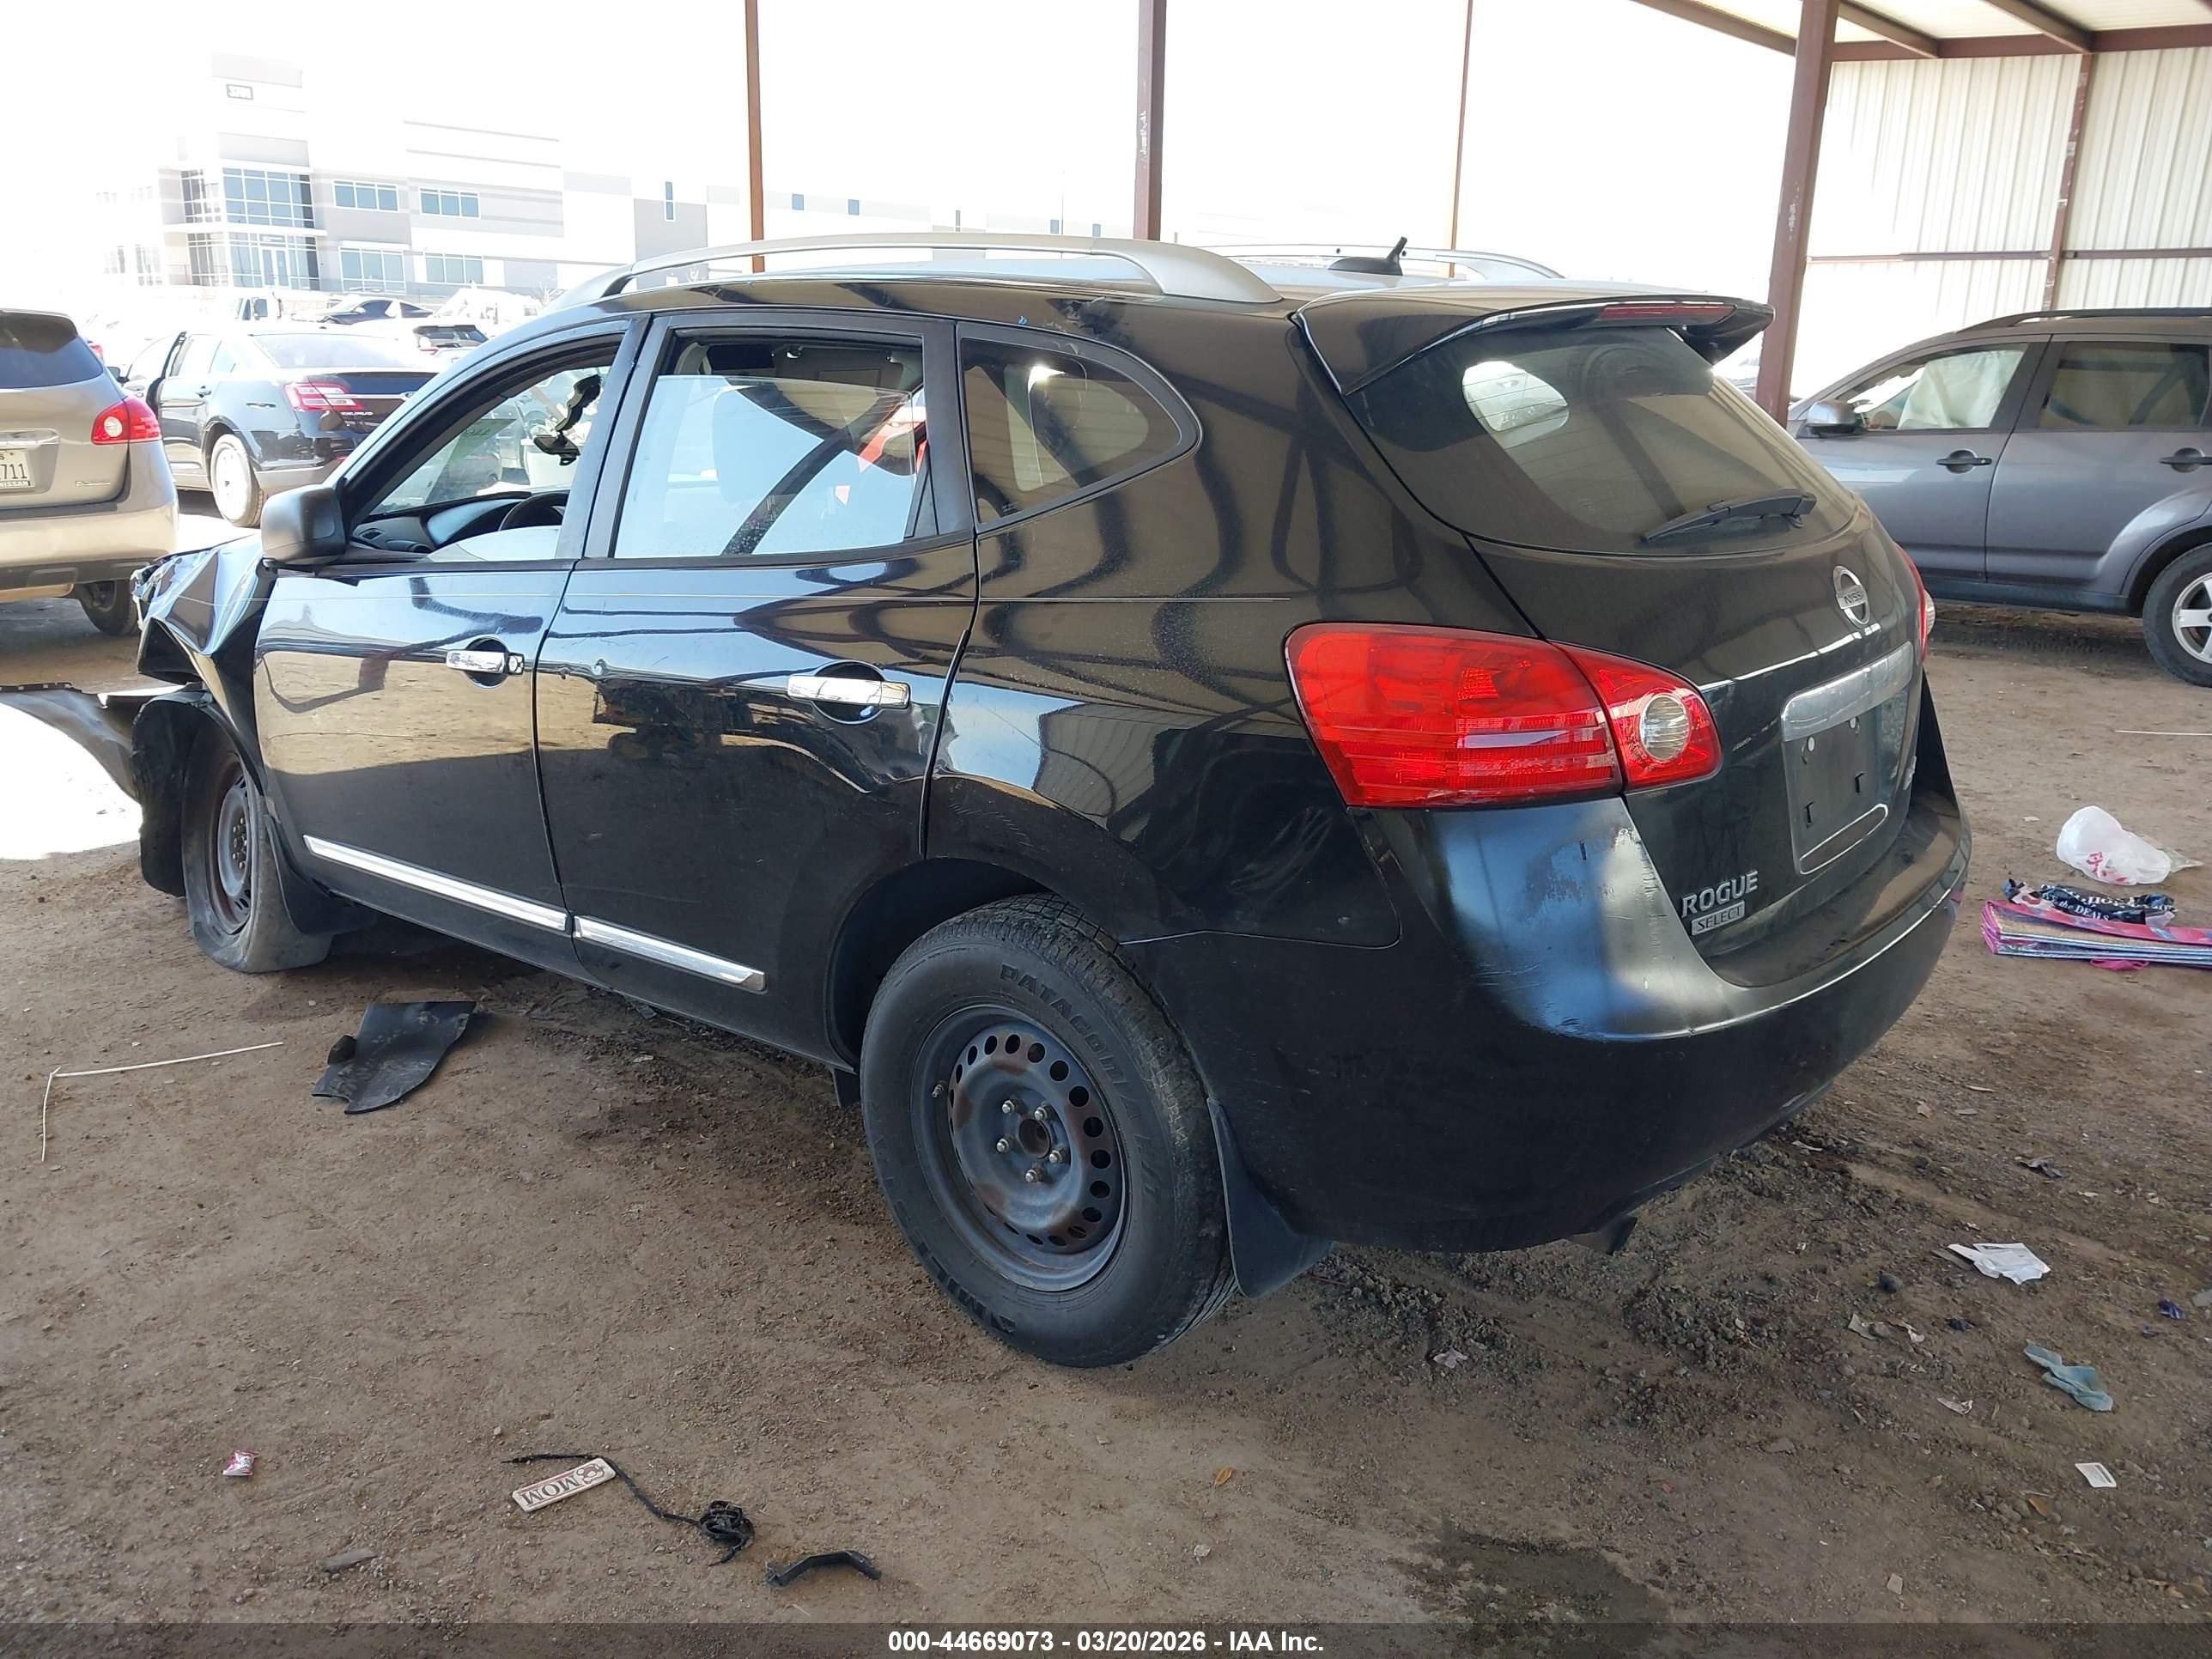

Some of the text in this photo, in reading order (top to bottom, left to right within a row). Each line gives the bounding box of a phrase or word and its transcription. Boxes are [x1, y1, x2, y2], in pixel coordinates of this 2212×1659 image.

[1681, 870, 1758, 918] ROGUE
[1697, 904, 1742, 931] SELECT
[2058, 900, 2110, 921] the DEALS
[521, 1475, 580, 1505] MOM
